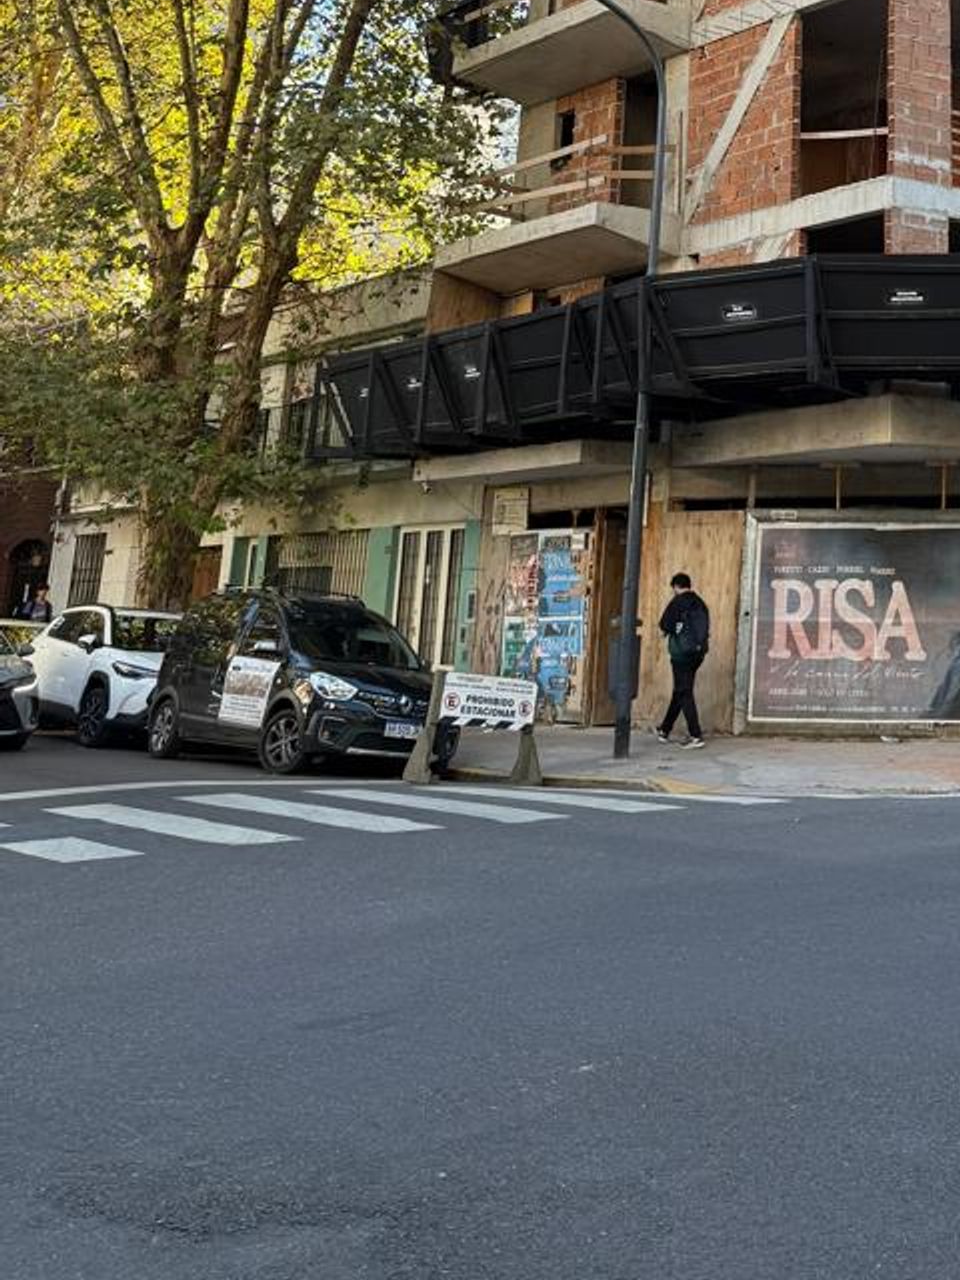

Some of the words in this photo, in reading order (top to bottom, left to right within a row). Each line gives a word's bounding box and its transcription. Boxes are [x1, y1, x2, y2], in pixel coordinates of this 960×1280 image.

[767, 577, 927, 661] RISA
[466, 694, 515, 708] PROHIBIDO
[460, 704, 516, 719] ESTACIONAR
